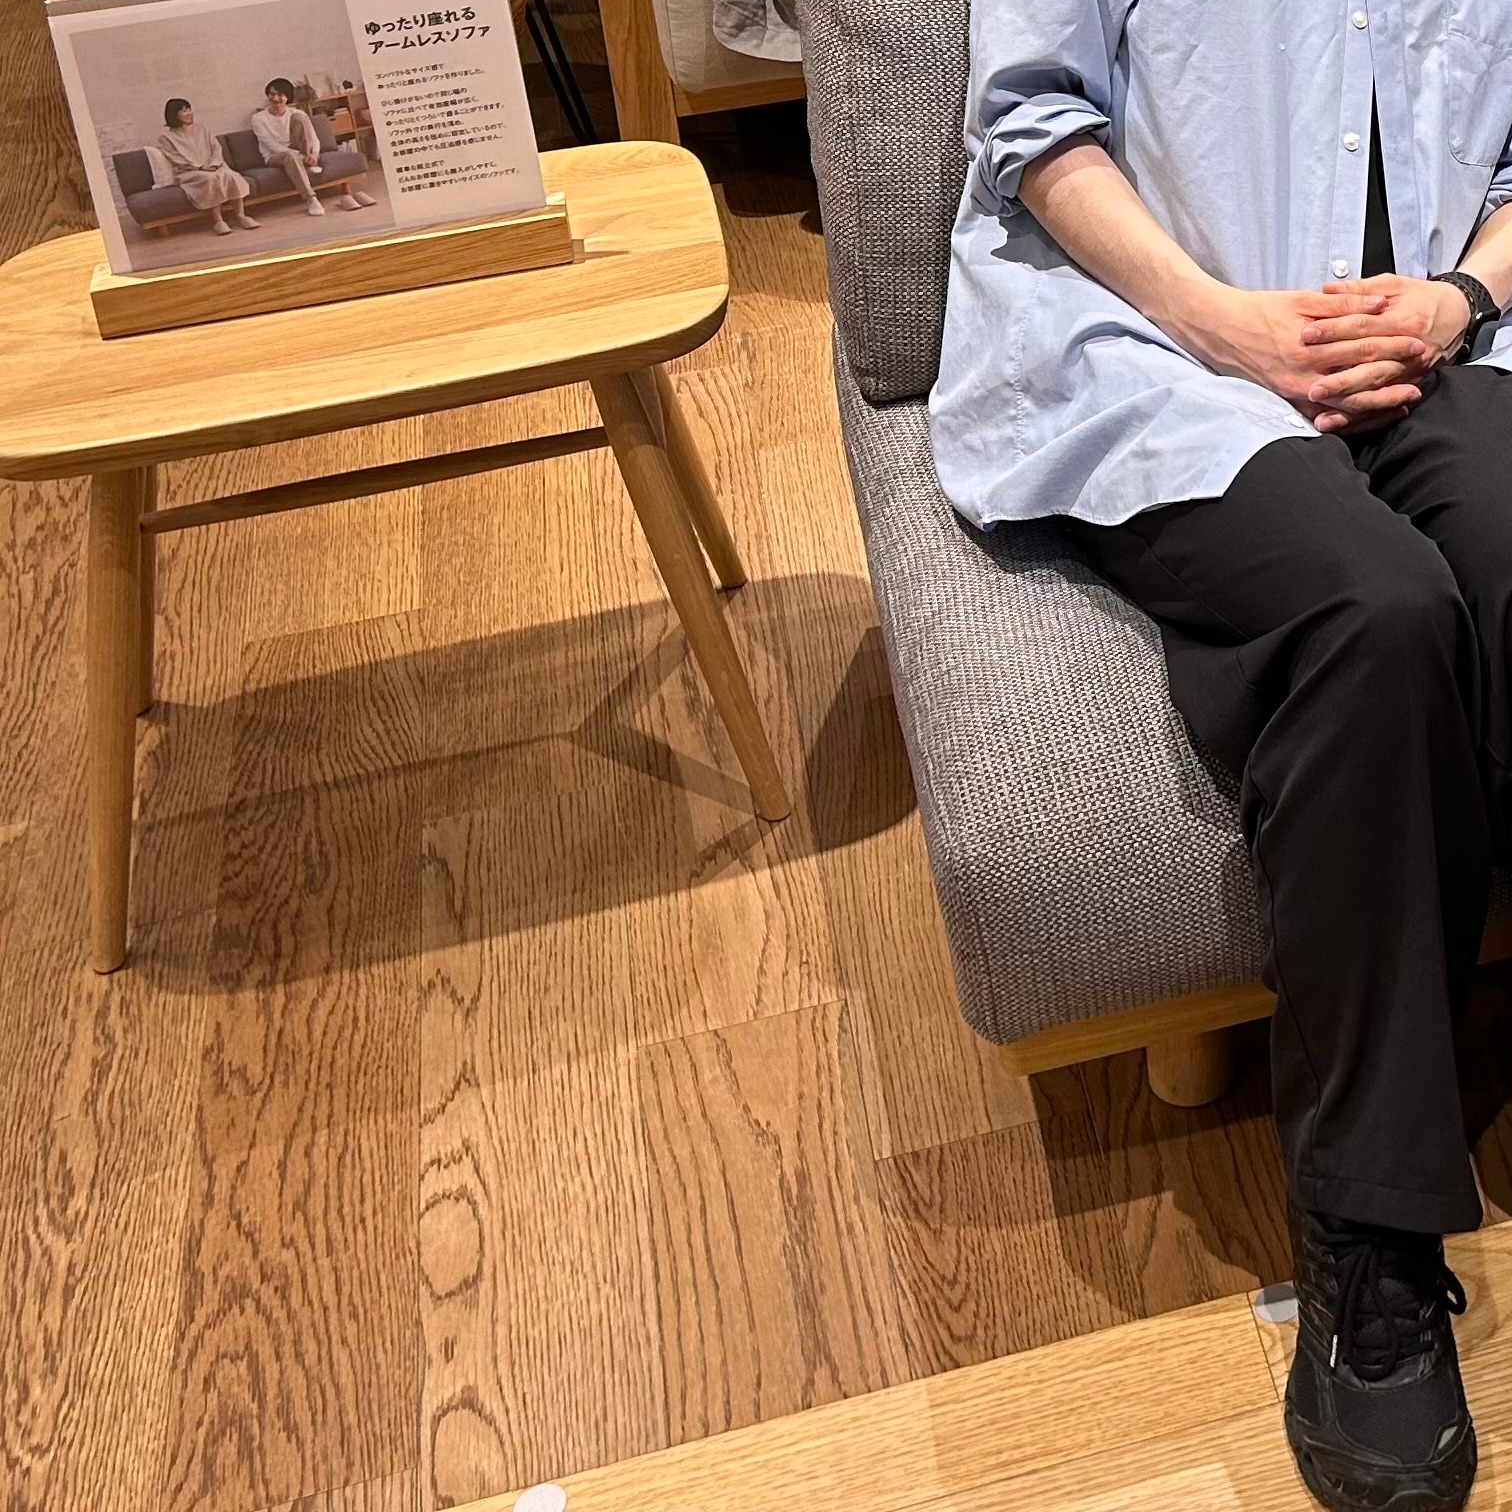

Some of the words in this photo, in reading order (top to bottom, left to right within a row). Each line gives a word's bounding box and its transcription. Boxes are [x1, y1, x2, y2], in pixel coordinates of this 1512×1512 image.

[364, 6, 477, 36] ゆったり座れる
[368, 25, 492, 55] アームレスソファ
